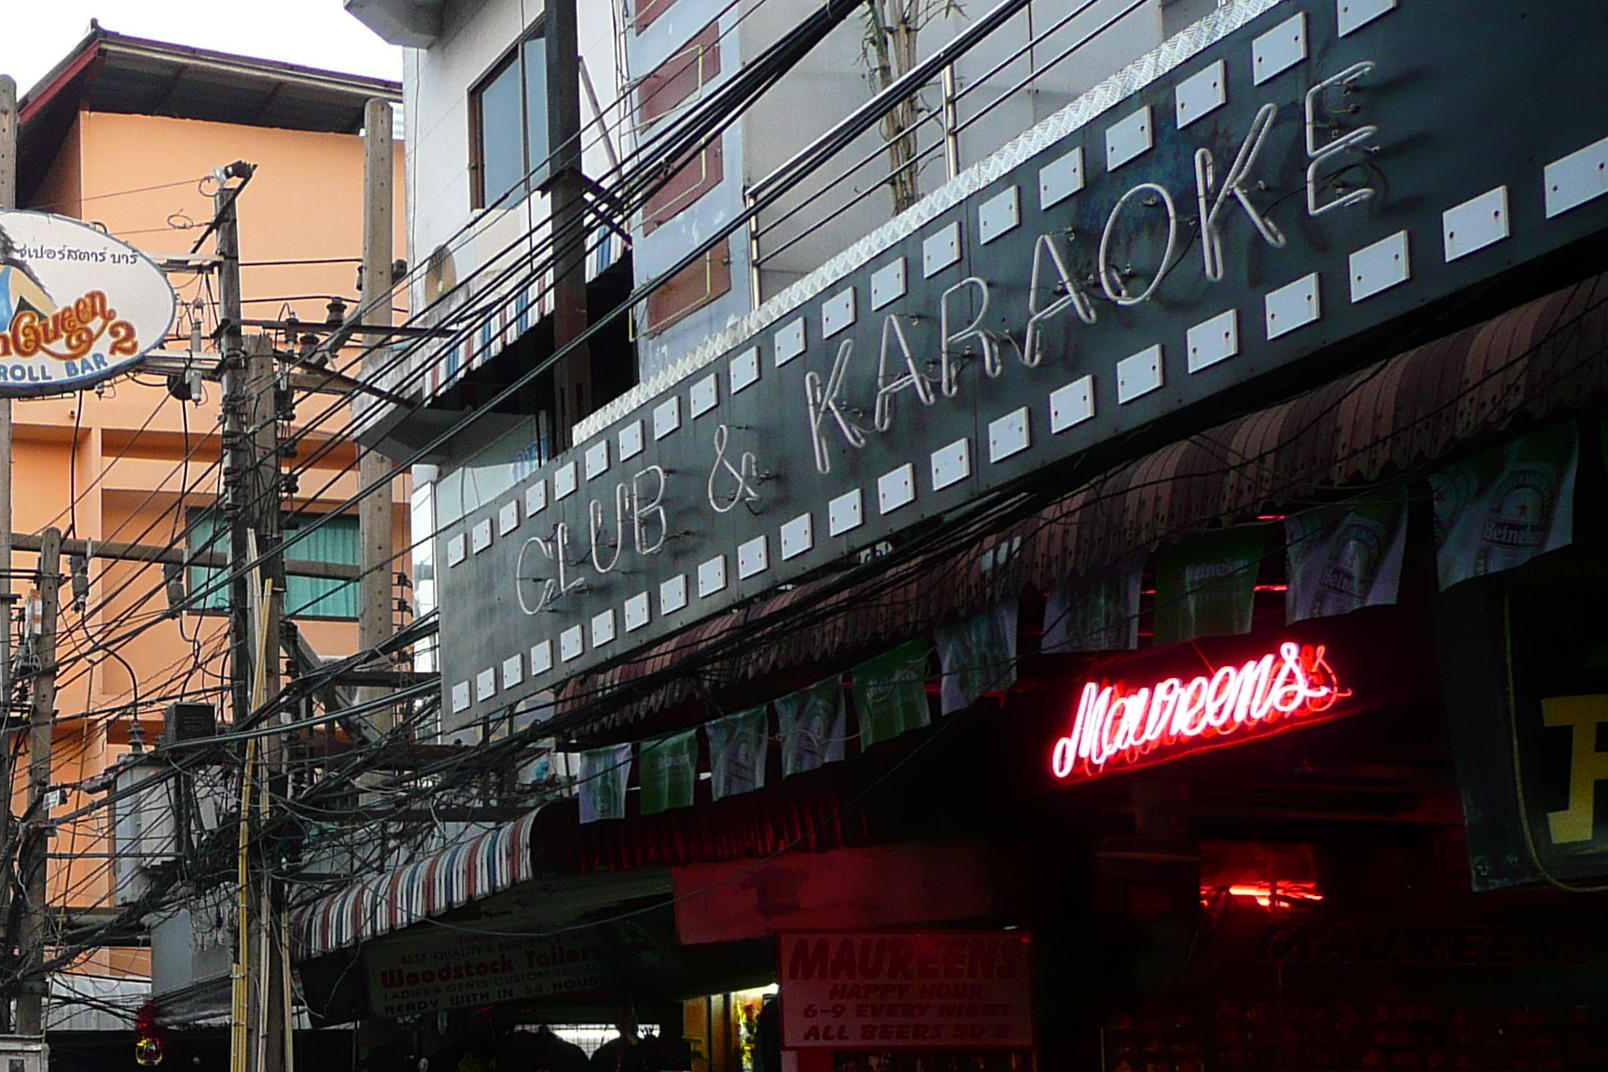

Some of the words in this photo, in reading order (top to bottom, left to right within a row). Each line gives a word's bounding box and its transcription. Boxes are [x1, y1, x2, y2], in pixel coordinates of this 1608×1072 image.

[804, 60, 1378, 476] KARAOKE
[10, 290, 116, 360] Queen
[108, 320, 139, 356] 2
[65, 352, 109, 377] BAR
[516, 463, 668, 616] CLUB
[708, 423, 762, 514] &
[380, 952, 513, 991] Woodstock
[400, 952, 427, 966] BEST
[788, 937, 1023, 982] MAUREENS
[382, 984, 436, 1001] LADIES
[446, 977, 490, 993] GENTS
[494, 969, 550, 987] CUSTOM
[828, 983, 912, 1001] HAPPY
[918, 983, 986, 1001] HOUR
[384, 998, 439, 1016] READY
[449, 988, 490, 1006] WITH
[496, 986, 515, 1001] IN
[803, 1003, 846, 1019] 6-9
[855, 1003, 930, 1018] EVERY
[937, 1003, 1013, 1018] NIGHT
[803, 1024, 850, 1041] ALL
[860, 1024, 945, 1041] BEERS
